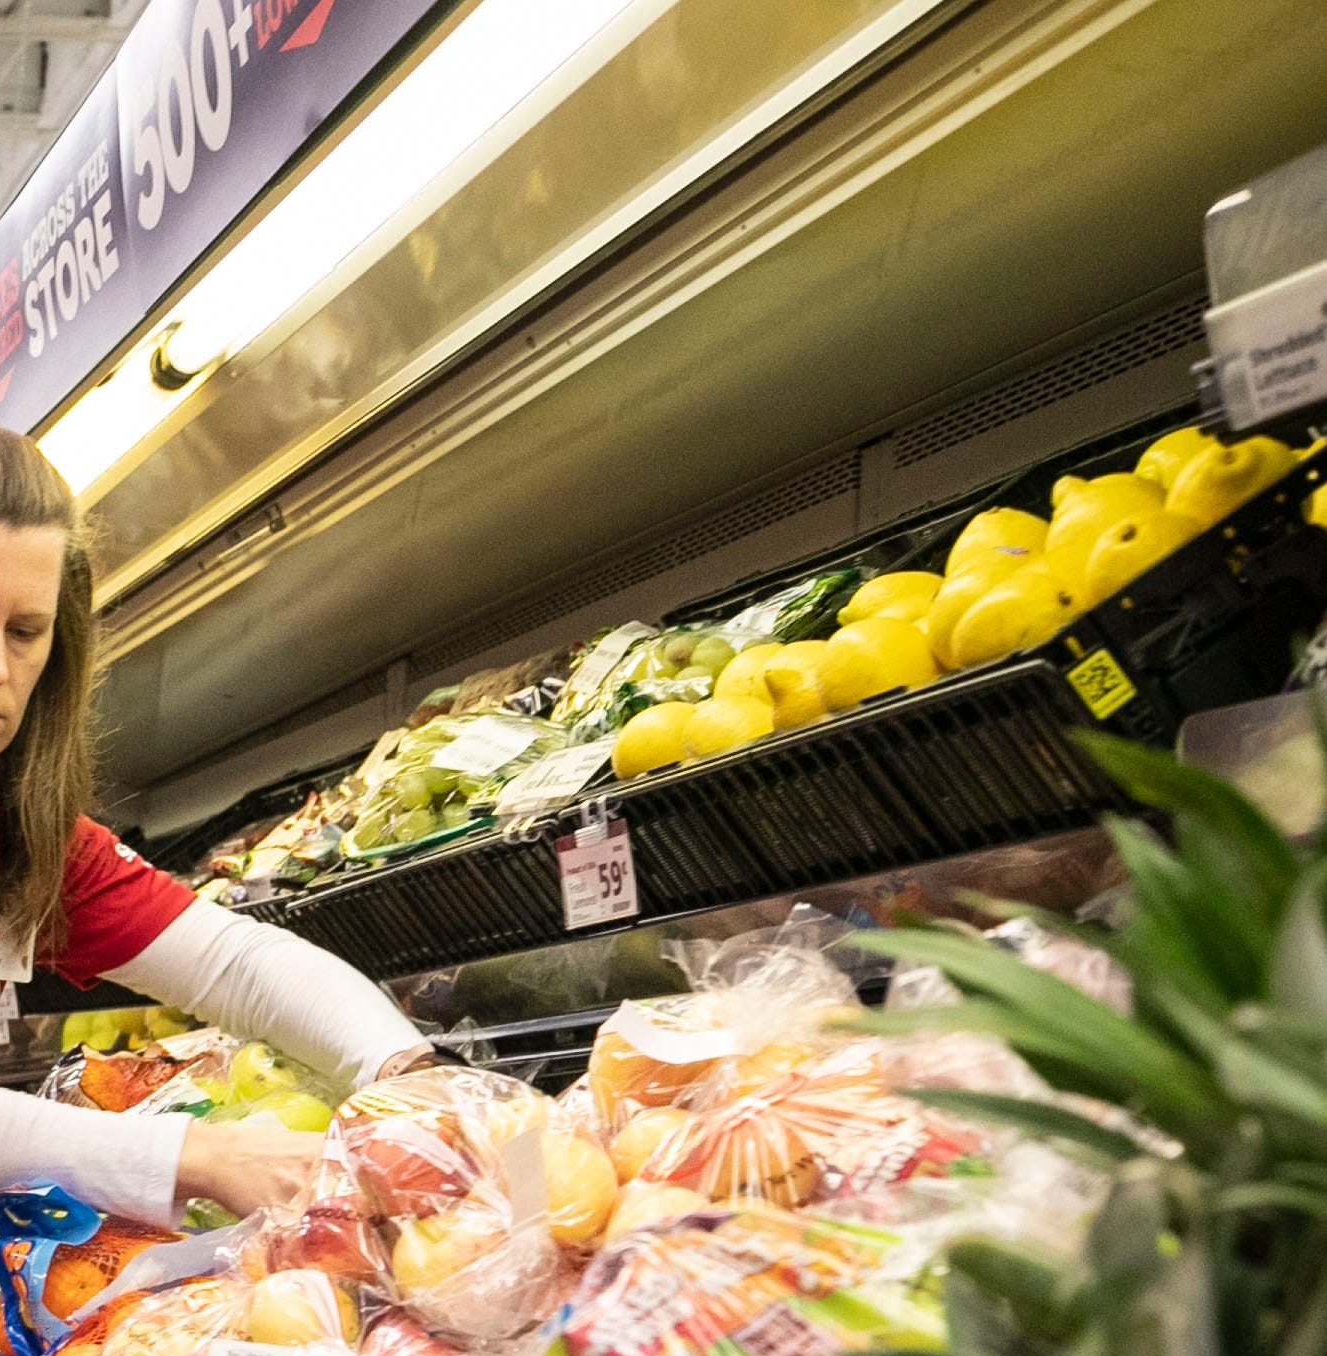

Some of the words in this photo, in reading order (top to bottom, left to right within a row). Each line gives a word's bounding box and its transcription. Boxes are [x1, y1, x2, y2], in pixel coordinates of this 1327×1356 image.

[22, 182, 77, 281] ACROSS
[77, 138, 110, 210] THE
[23, 190, 121, 358] STORE
